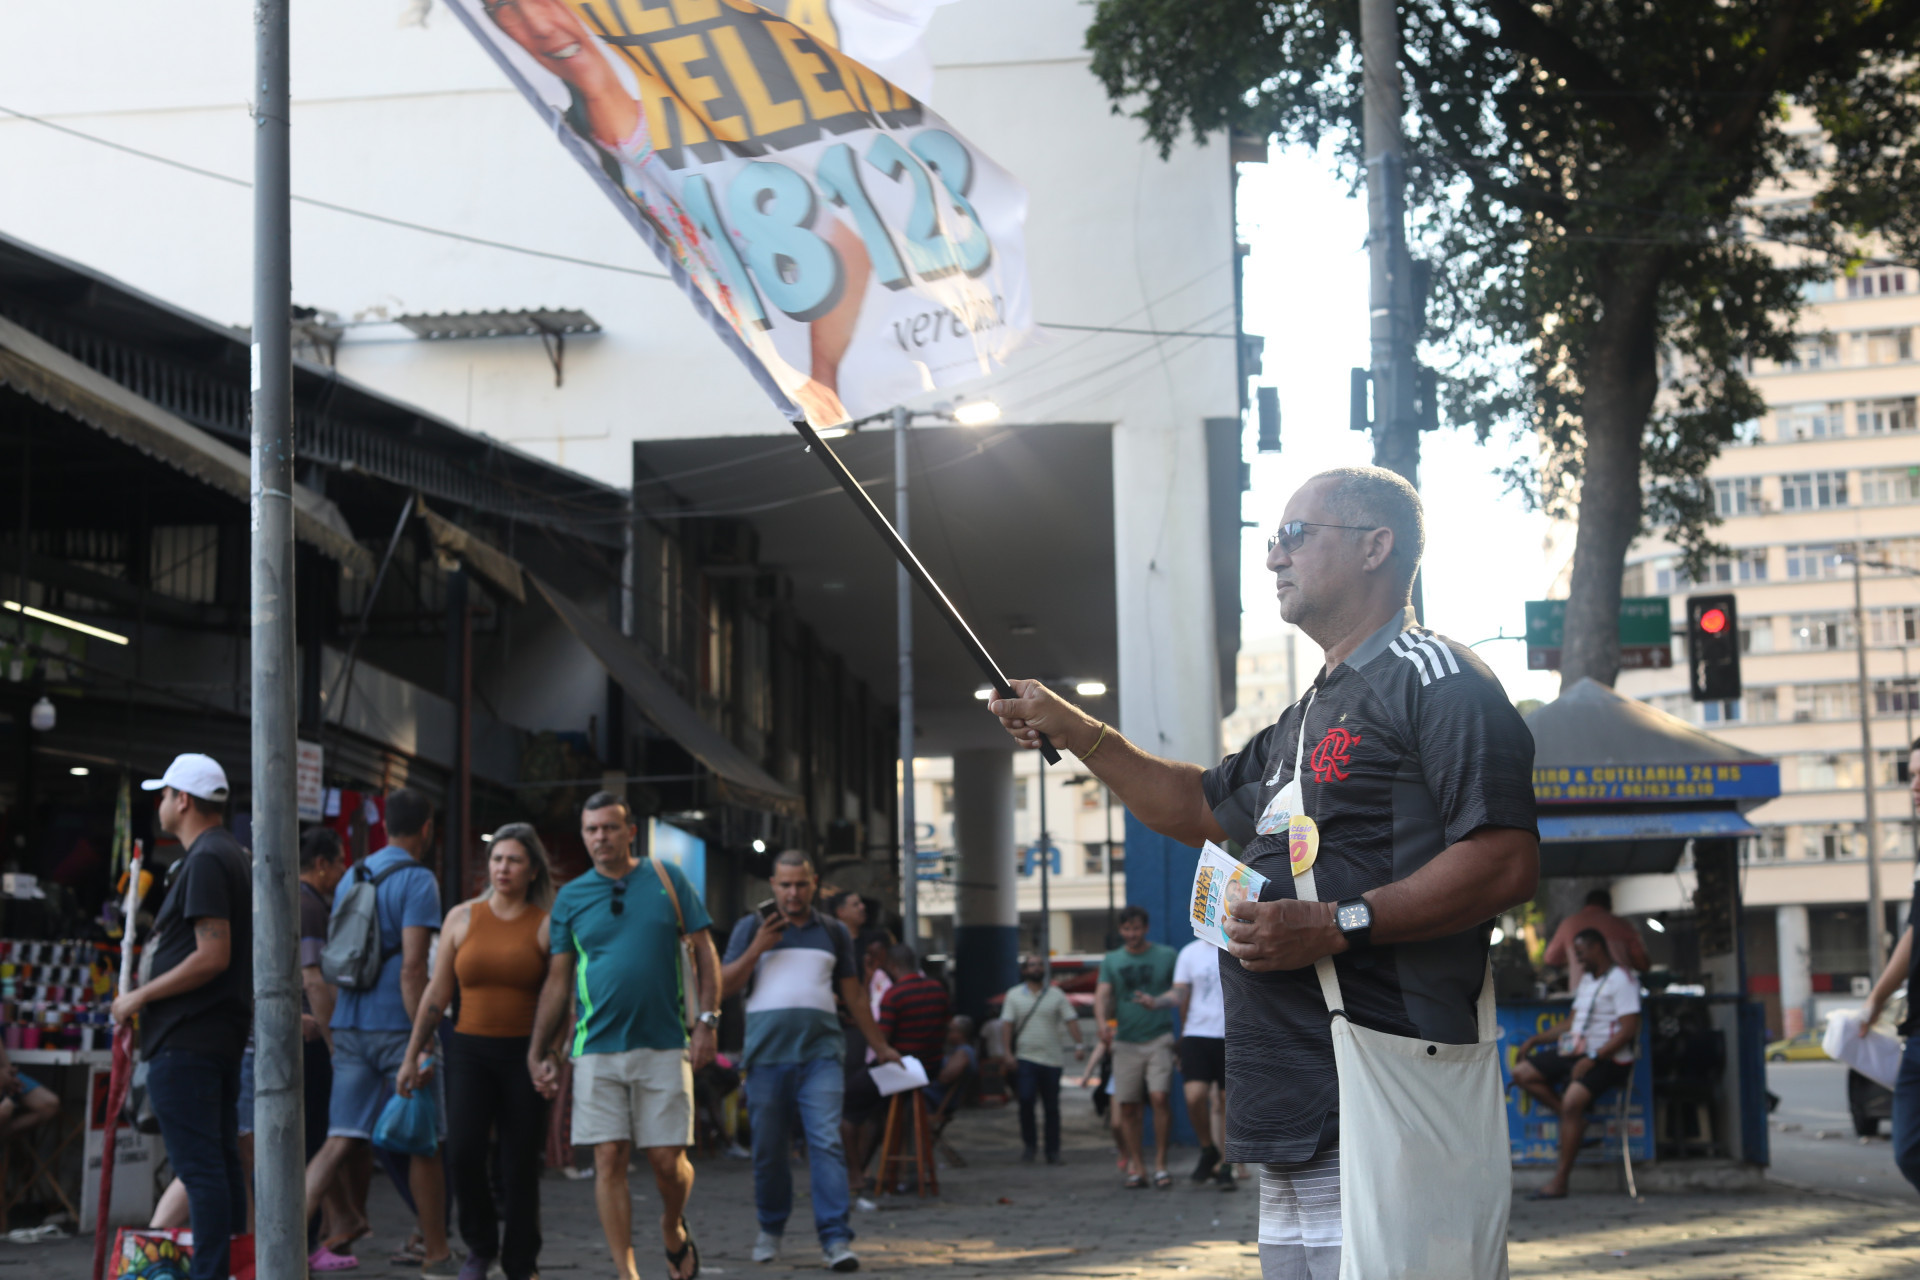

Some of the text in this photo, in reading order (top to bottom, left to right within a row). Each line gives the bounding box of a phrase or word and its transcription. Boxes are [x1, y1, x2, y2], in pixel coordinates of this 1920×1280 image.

[607, 20, 914, 151] HELEN
[683, 128, 993, 332] 18123
[1196, 866, 1215, 924] HELENA
[1205, 868, 1224, 928] 18123
